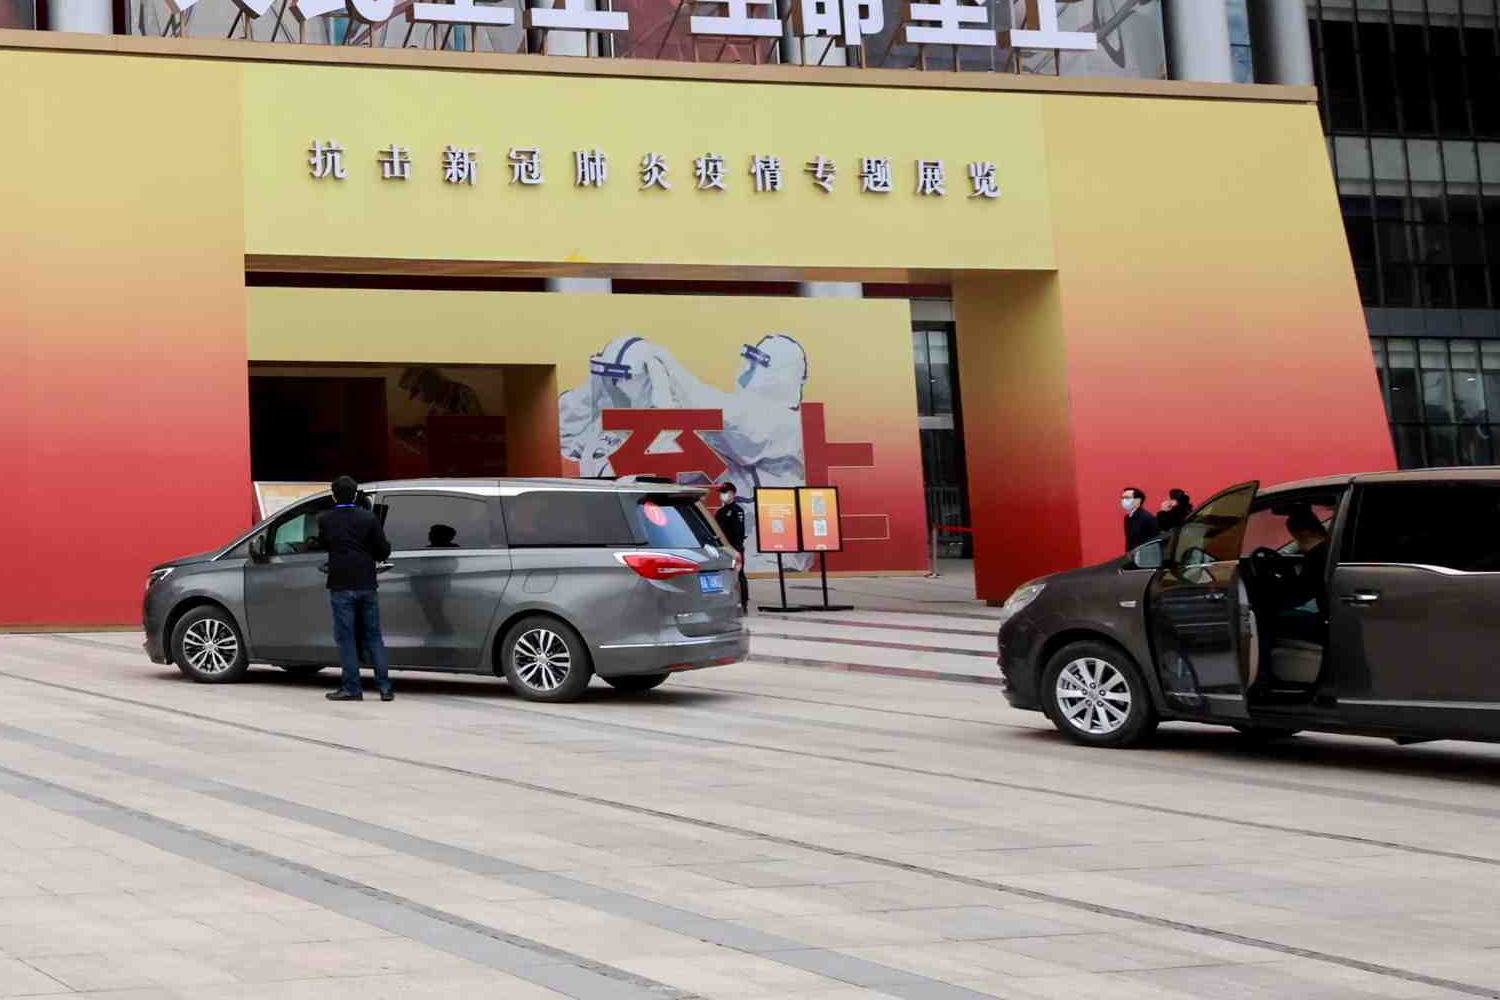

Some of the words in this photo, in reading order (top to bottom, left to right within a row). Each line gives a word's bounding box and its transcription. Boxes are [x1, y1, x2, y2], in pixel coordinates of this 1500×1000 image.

[308, 139, 1001, 199] 抗击新冠肺炎疫情专题展览
